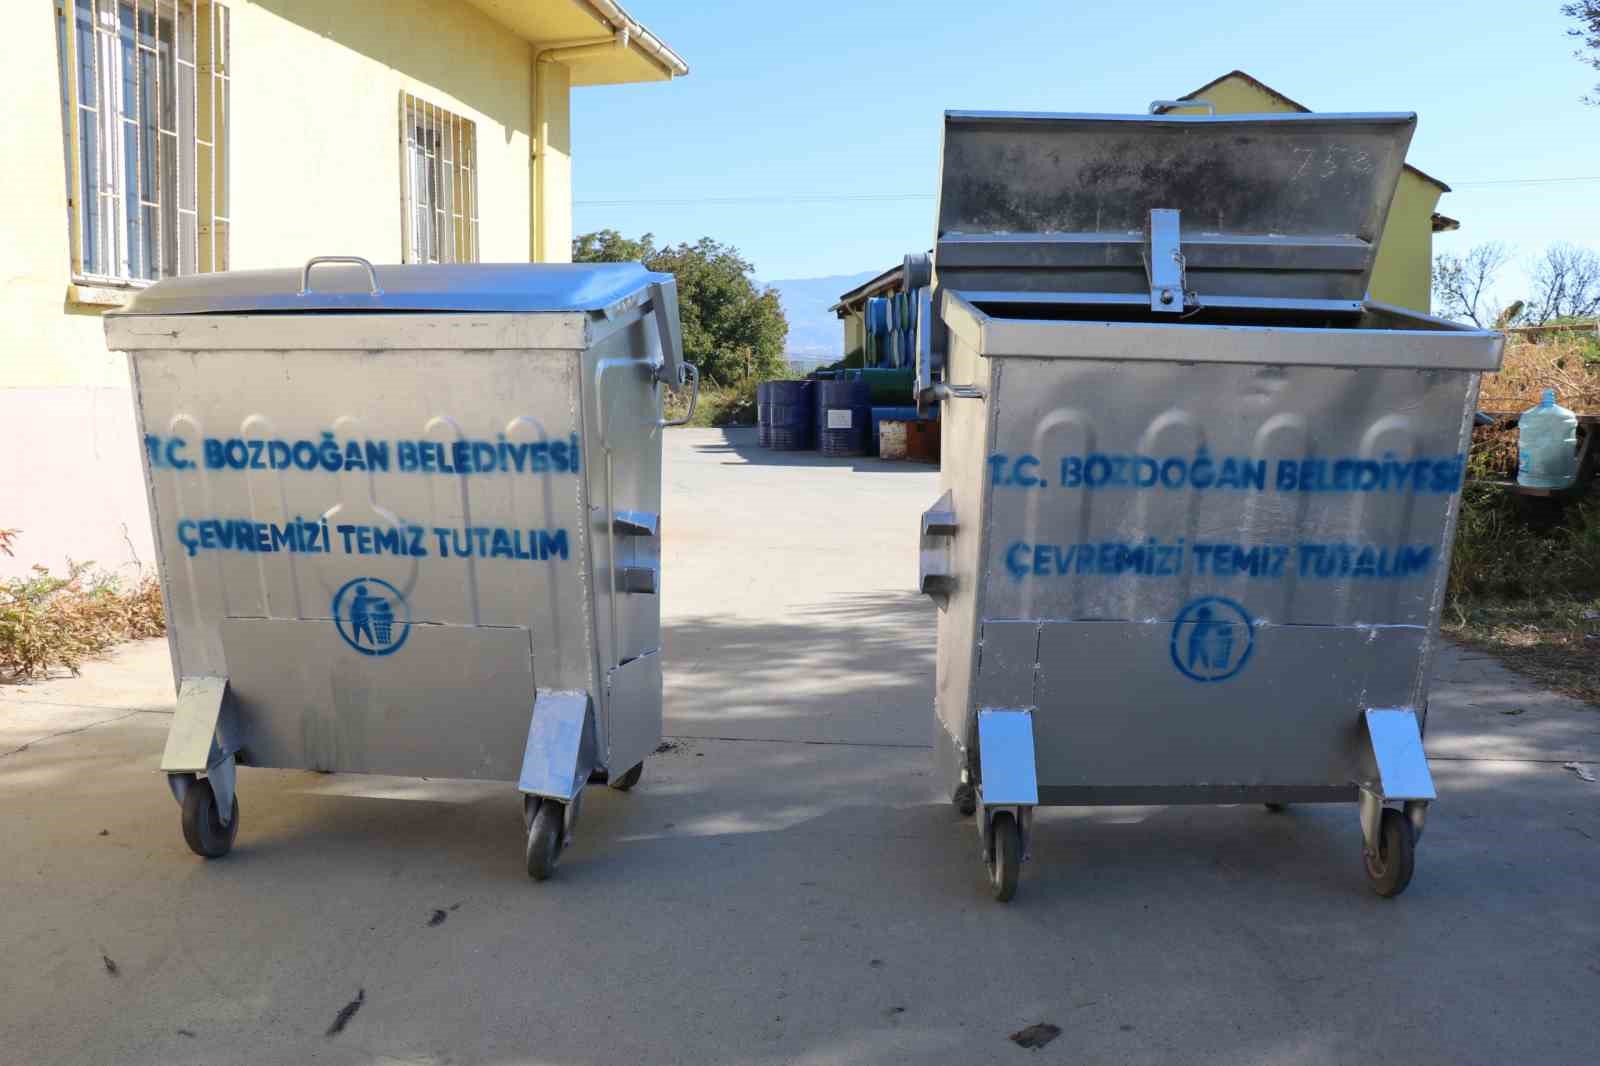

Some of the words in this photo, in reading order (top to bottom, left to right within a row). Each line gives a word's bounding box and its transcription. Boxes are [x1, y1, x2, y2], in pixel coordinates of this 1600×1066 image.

[204, 433, 389, 471] BOZDOĞAN
[397, 433, 581, 473] BELEDİYESİ
[987, 454, 1048, 487] T.C.
[1060, 445, 1266, 491] BOZDOĞAN
[177, 515, 330, 557] ÇEVREMİZİ
[433, 528, 570, 560] TUTALIM
[1005, 536, 1186, 583] ÇEVREMİZİ
[1299, 543, 1434, 578] TUTALIM
